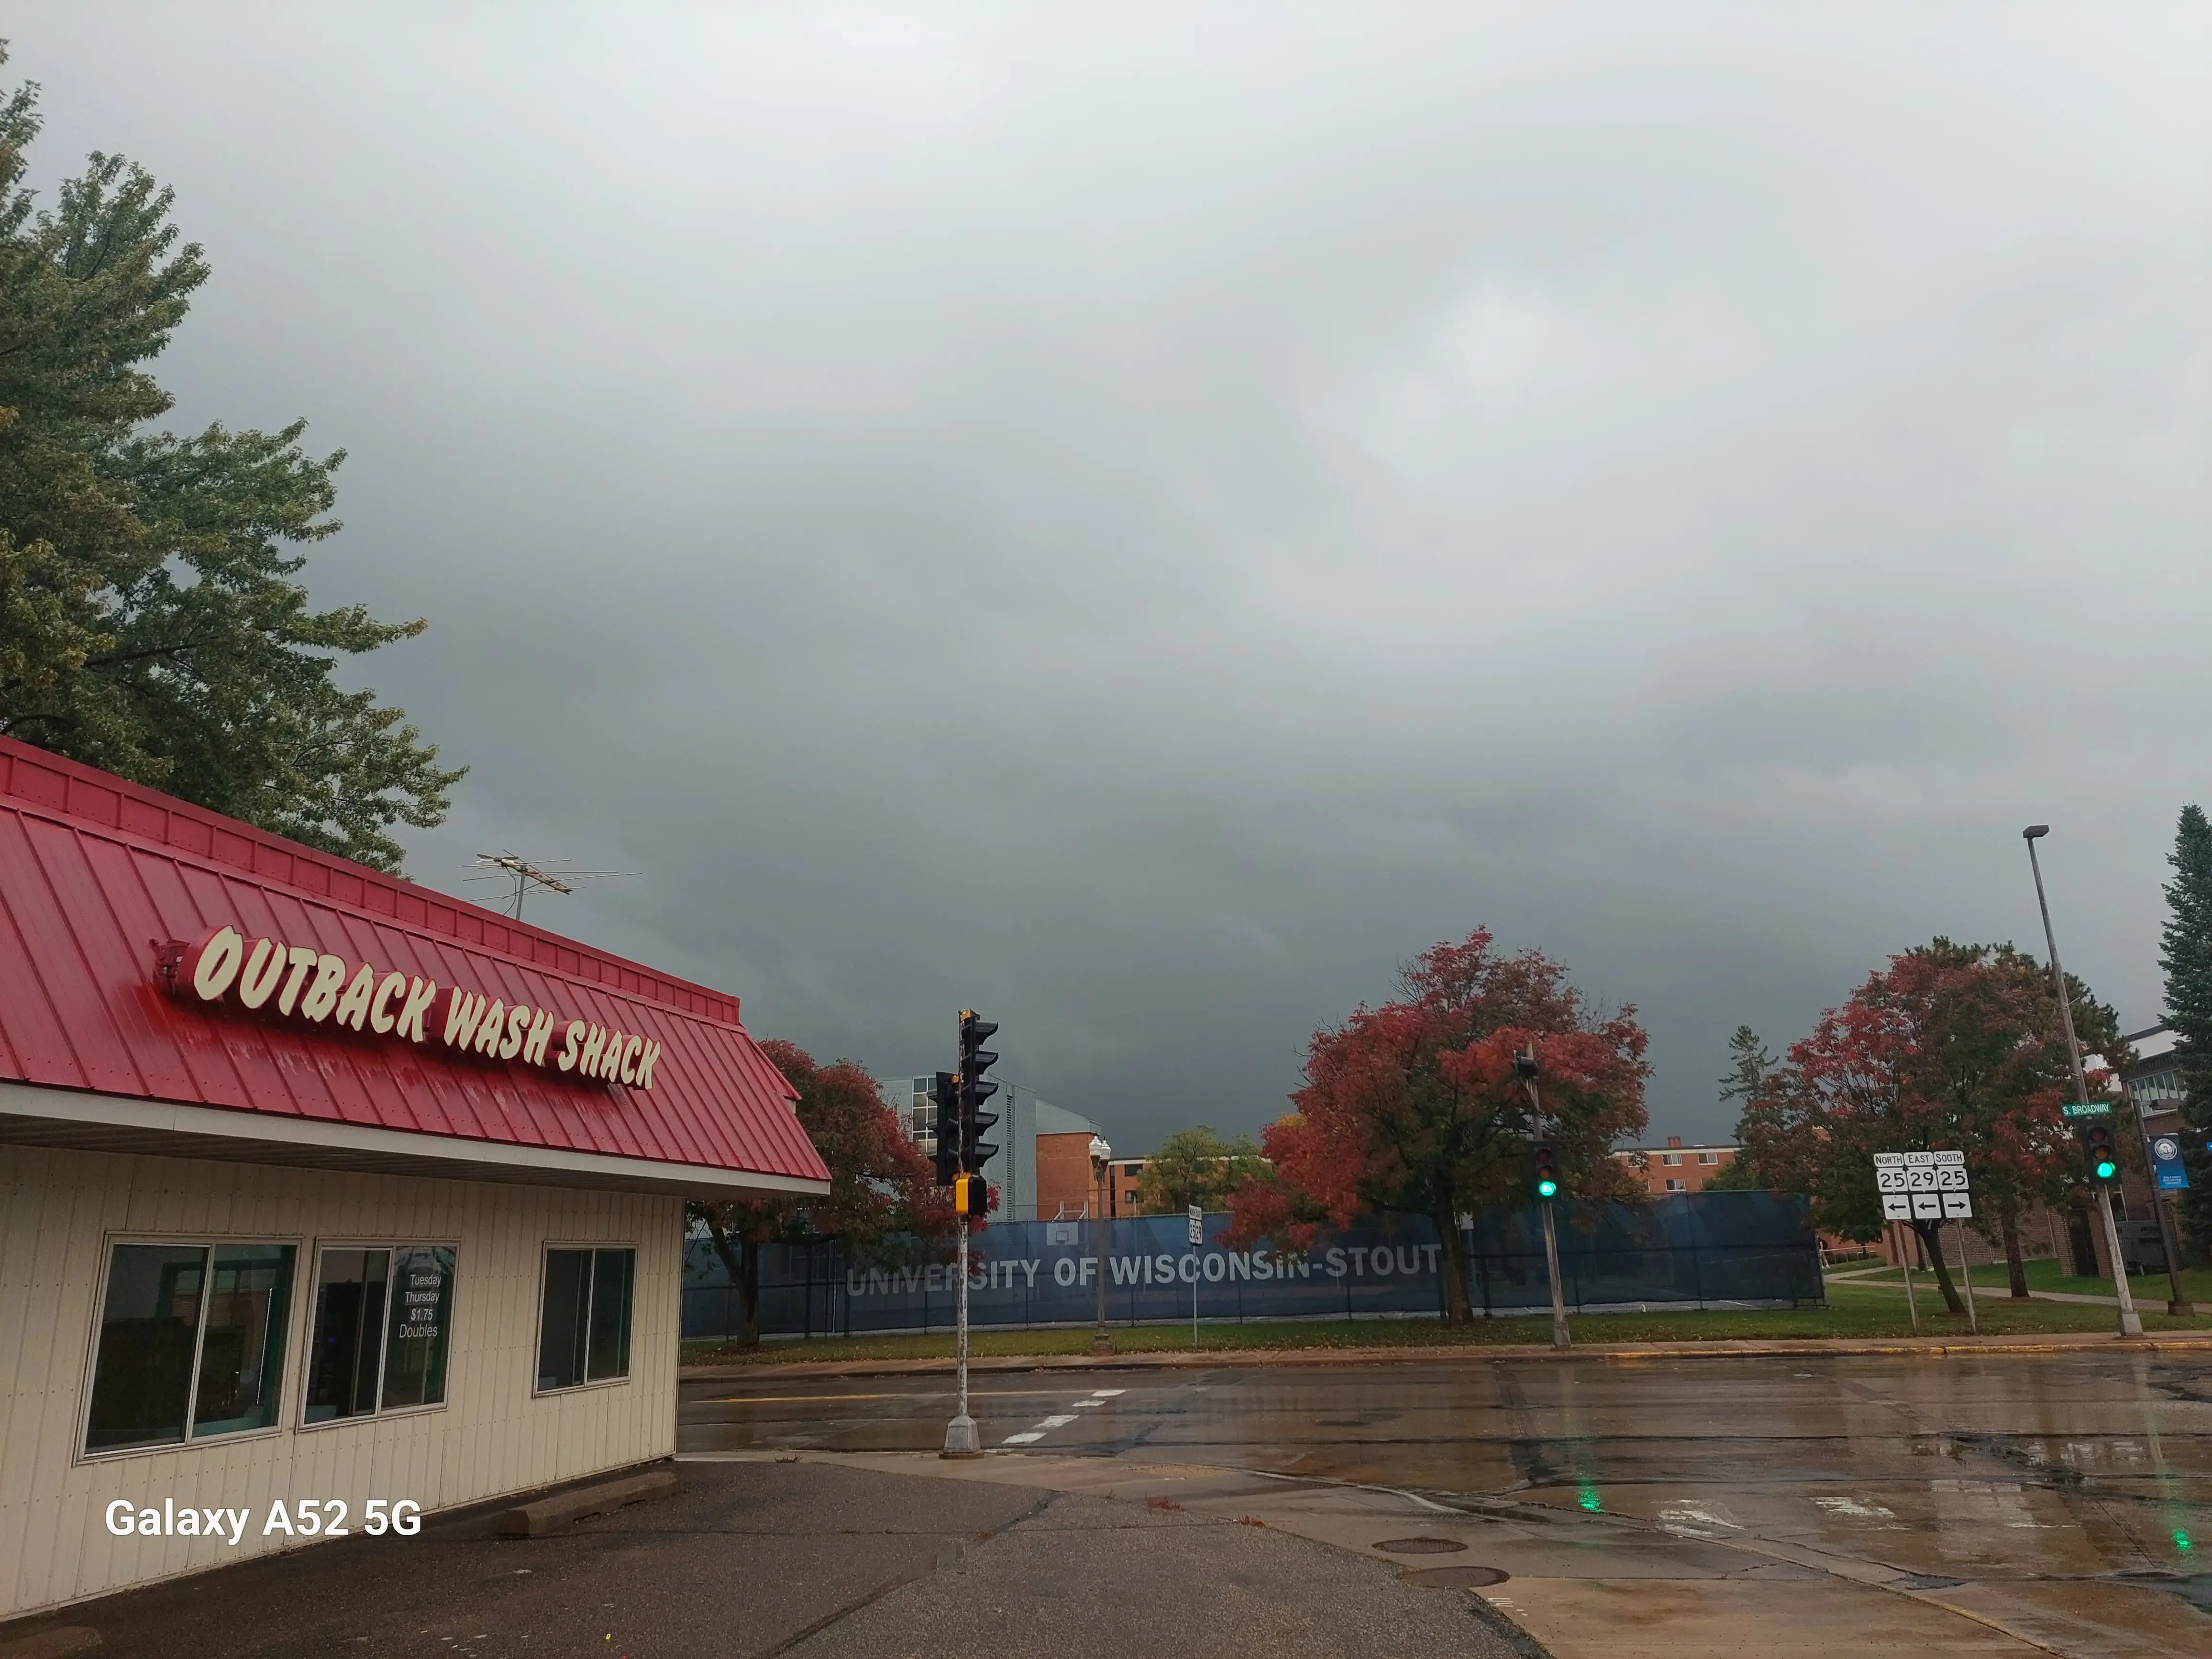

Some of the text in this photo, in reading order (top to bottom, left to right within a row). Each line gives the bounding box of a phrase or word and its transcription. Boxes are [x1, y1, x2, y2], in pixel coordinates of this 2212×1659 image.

[194, 926, 661, 1090] OUTBACK WASH SHACK
[2063, 1103, 2109, 1115] S. BROADWAY
[1875, 1155, 1902, 1164] NORTH
[1908, 1154, 1929, 1163] EAST
[1936, 1153, 1962, 1162] SOUTH
[1880, 1172, 1905, 1188] 25
[1910, 1172, 1934, 1187] 29
[1940, 1171, 1966, 1186] 25
[1190, 1224, 1195, 1239] 25
[1196, 1225, 1201, 1239] 29
[1054, 1257, 1098, 1286] OF
[1109, 1244, 1442, 1285] WISCONSIN-STOUT
[410, 1274, 442, 1287] Tuesday
[405, 1291, 440, 1304] Thursday
[411, 1308, 433, 1321] $1.75
[399, 1323, 438, 1338] Doubles
